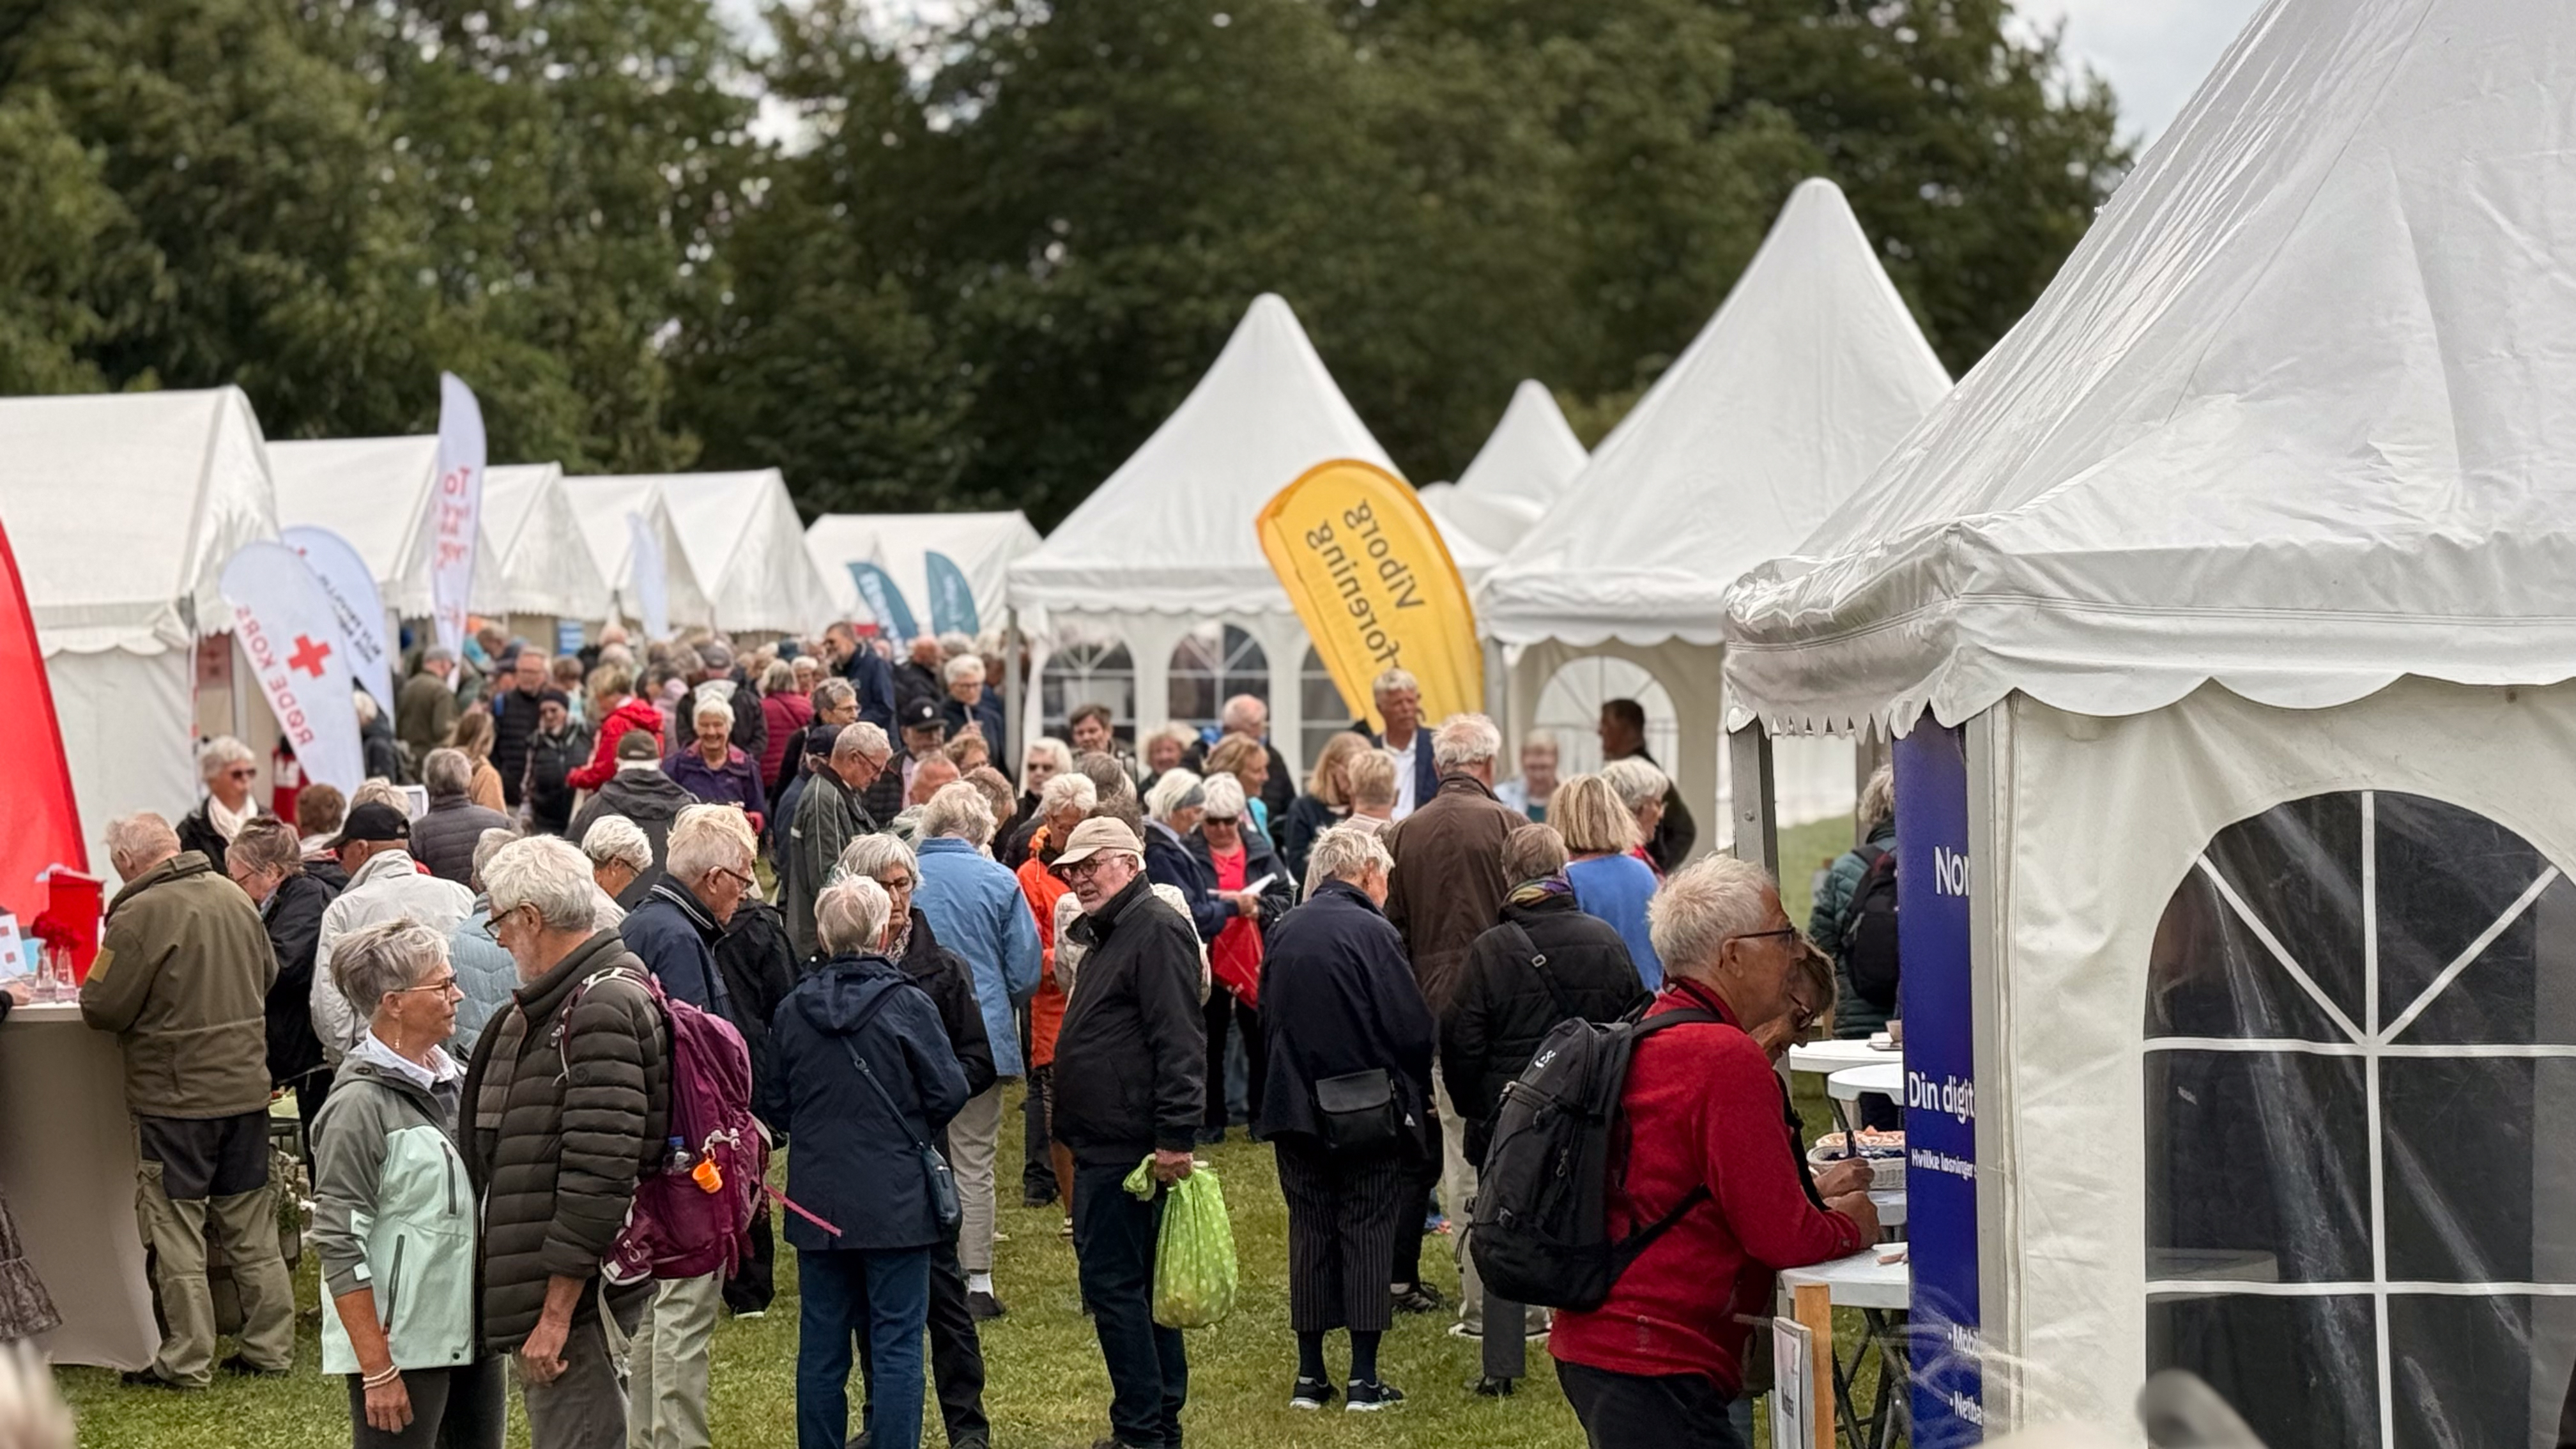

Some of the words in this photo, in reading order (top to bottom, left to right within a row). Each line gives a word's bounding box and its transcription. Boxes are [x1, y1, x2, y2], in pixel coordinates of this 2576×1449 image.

[1908, 1071, 1940, 1111] Din
[1942, 1075, 1975, 1124] digit
[1911, 1149, 1940, 1170] Hvilke
[1954, 1390, 1982, 1426] Netba
